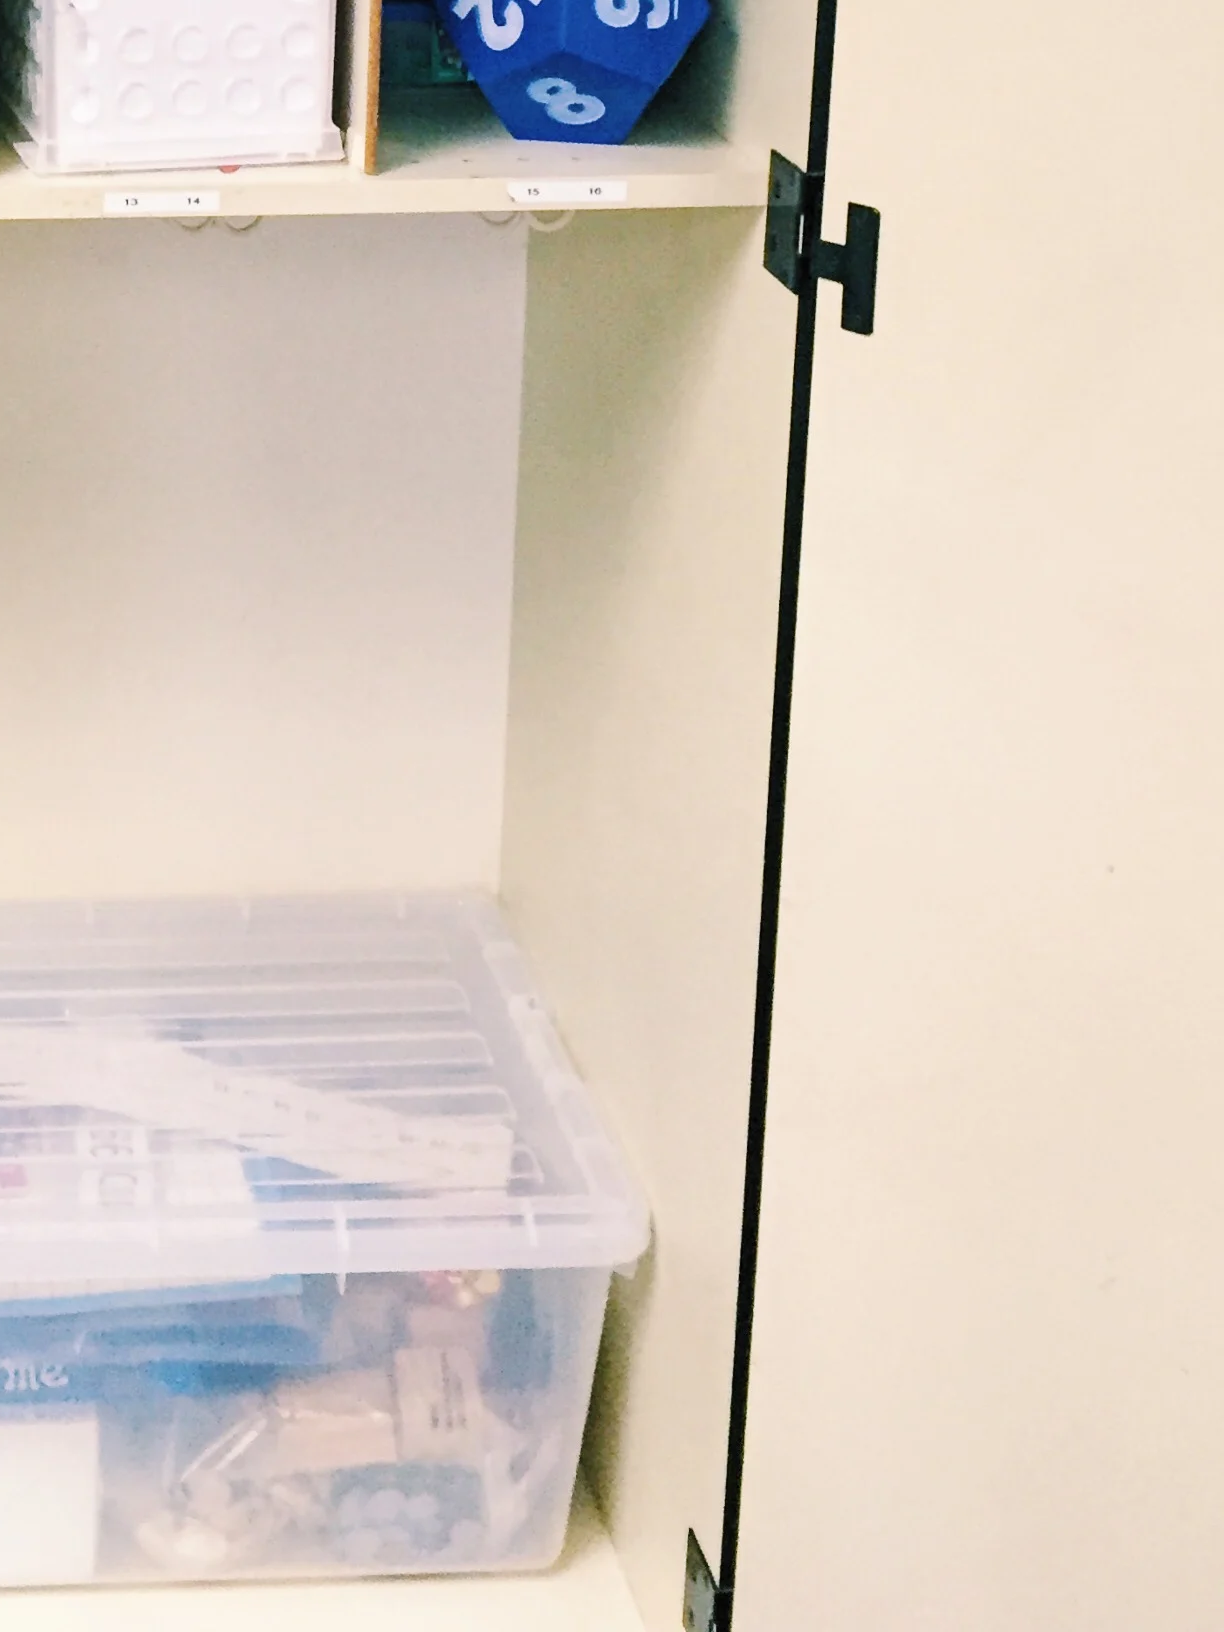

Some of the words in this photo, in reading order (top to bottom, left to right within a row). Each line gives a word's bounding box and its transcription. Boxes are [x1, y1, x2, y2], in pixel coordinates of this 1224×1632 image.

[526, 77, 606, 125] 8
[527, 188, 540, 197] 15
[589, 186, 602, 196] 16
[187, 197, 201, 206] 14
